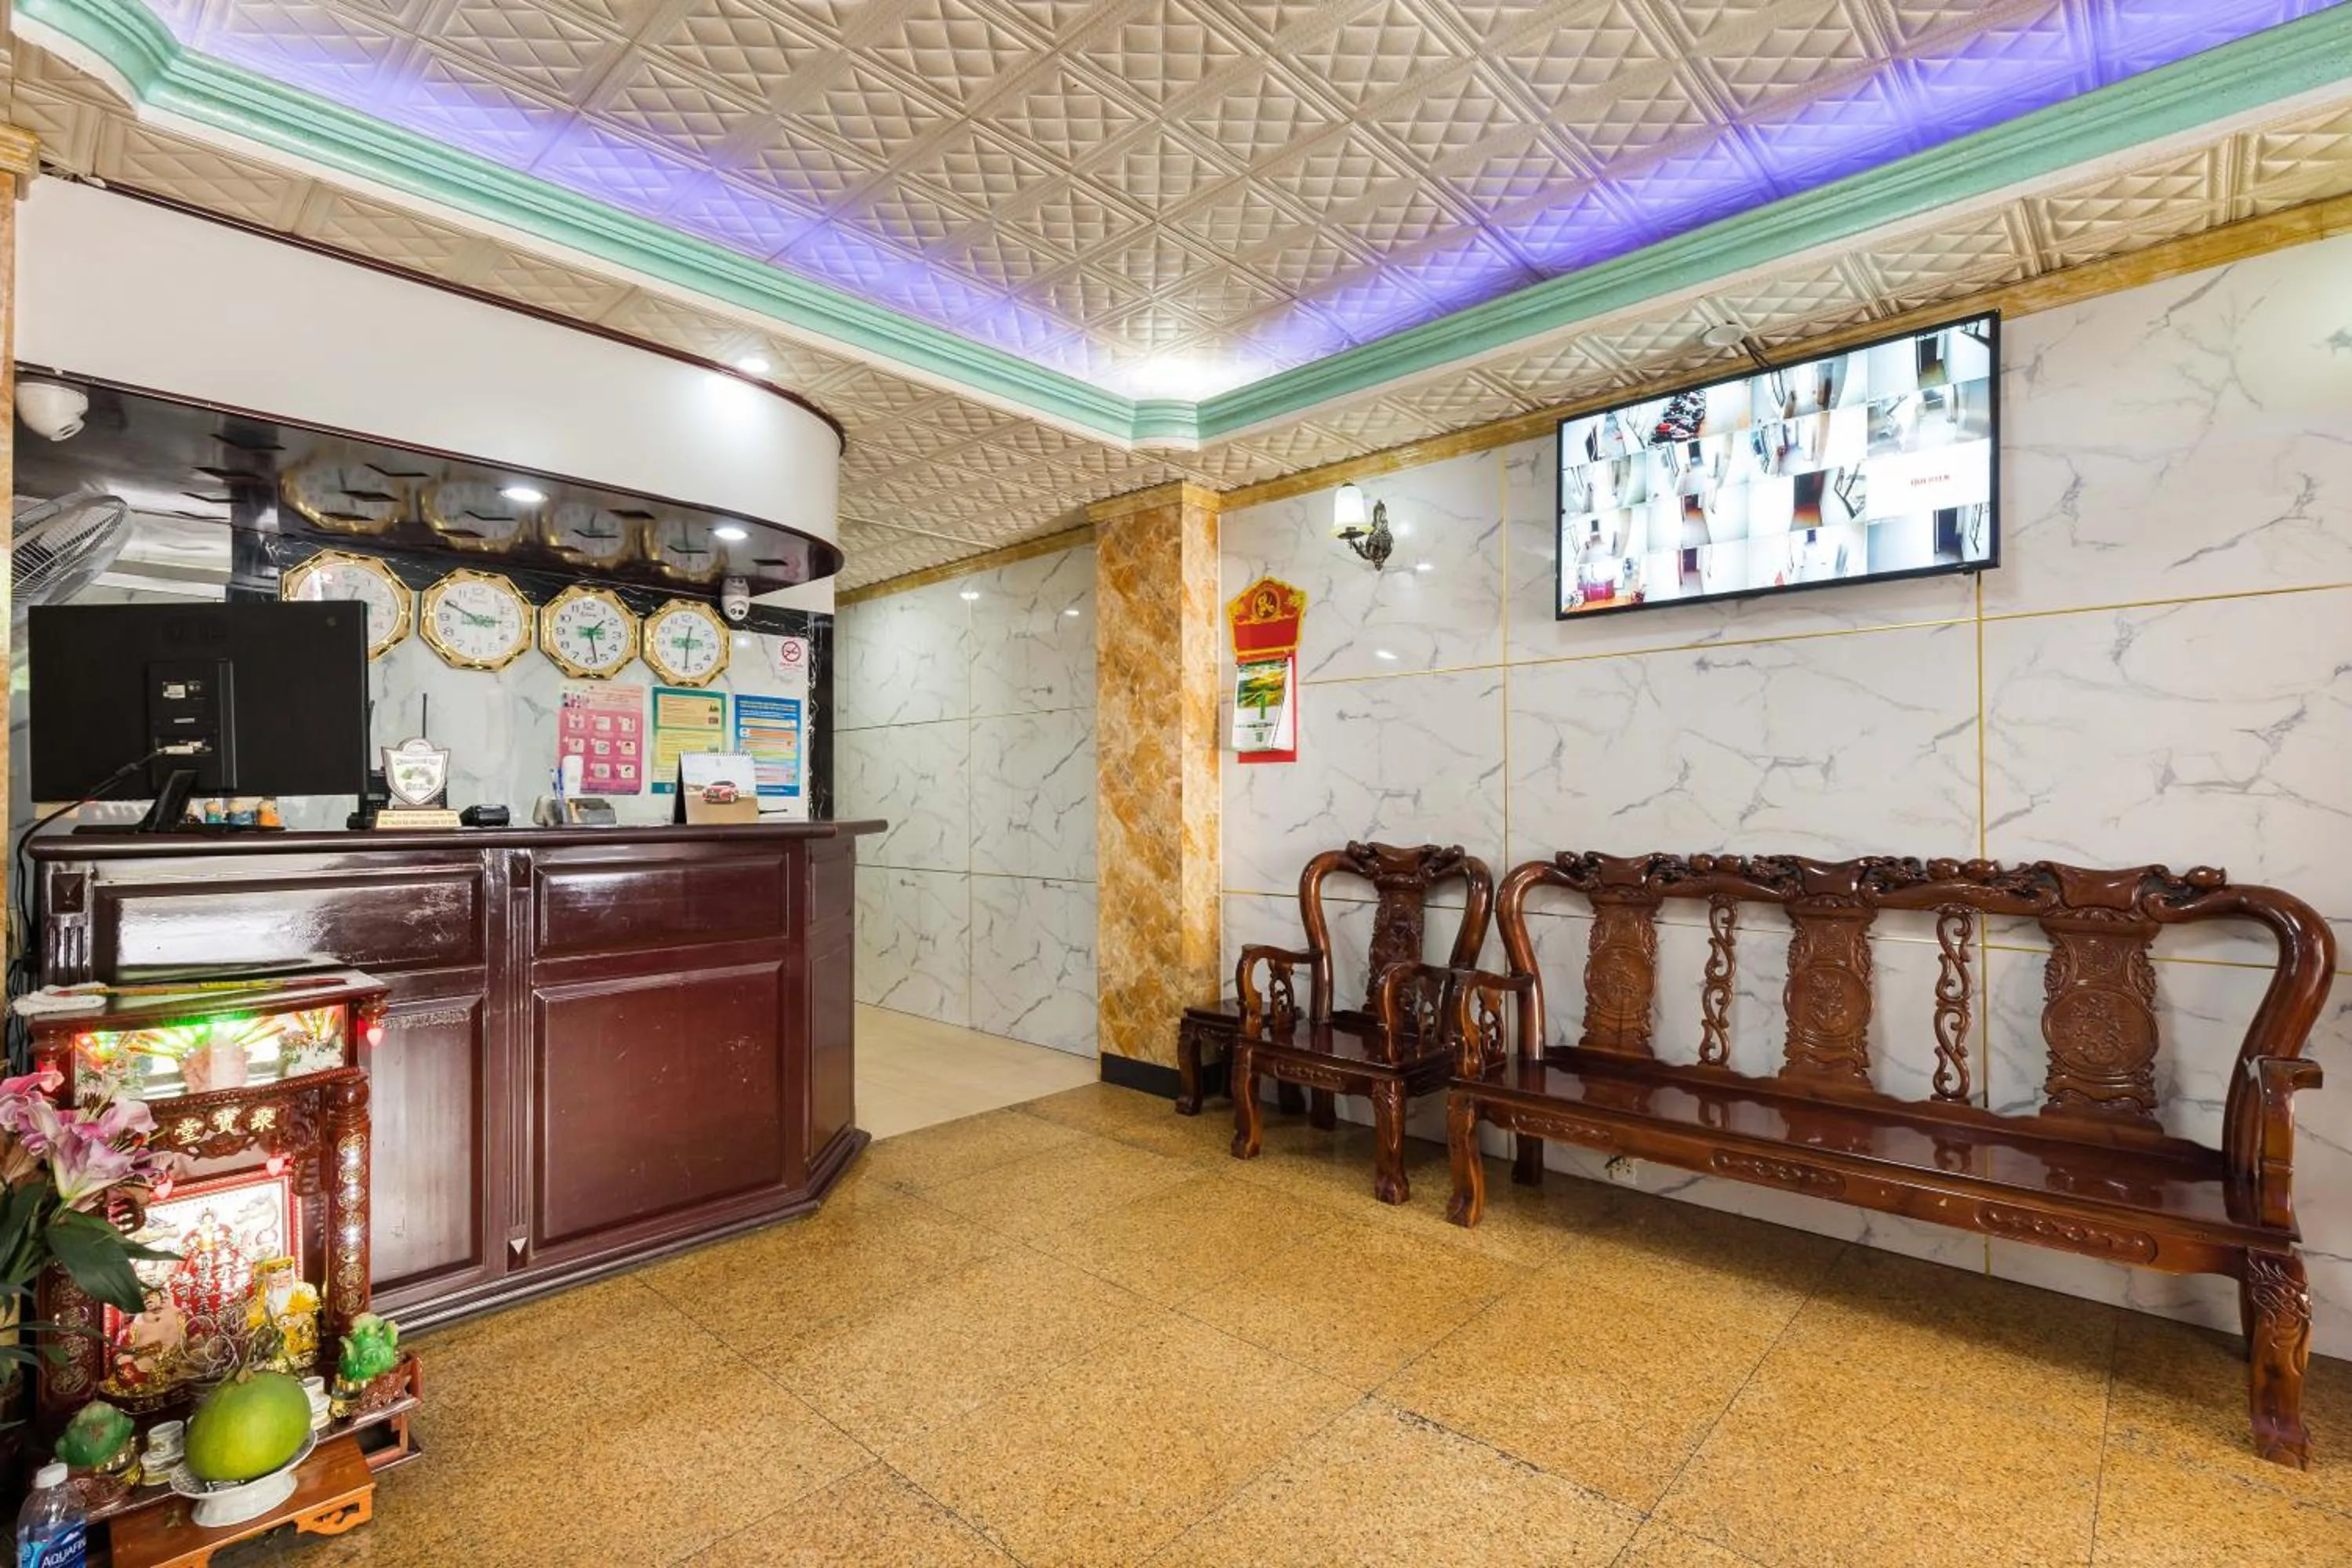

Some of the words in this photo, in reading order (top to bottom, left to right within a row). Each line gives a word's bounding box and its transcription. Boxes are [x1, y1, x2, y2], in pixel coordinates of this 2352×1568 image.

[572, 604, 579, 613] 11
[583, 601, 596, 611] 12
[560, 614, 572, 623] 10
[608, 644, 618, 652] 4
[571, 651, 579, 659] 7
